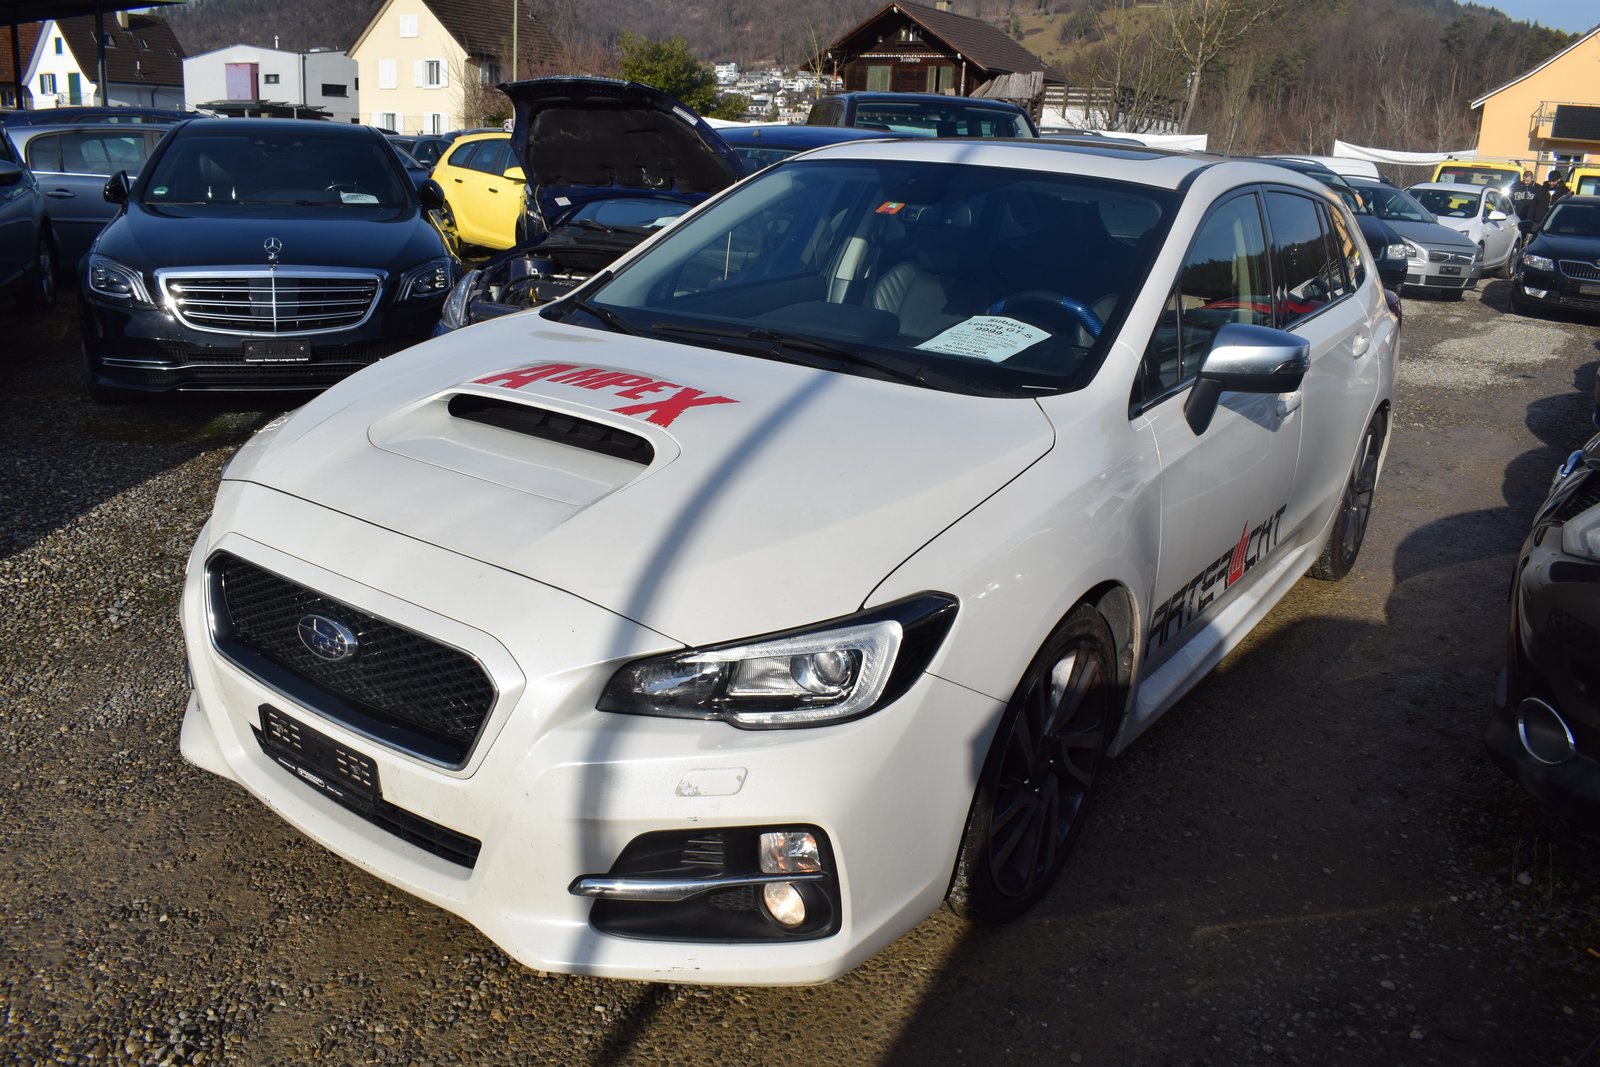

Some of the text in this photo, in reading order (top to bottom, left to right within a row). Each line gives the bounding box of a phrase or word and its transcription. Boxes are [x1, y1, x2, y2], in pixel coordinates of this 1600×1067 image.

[967, 321, 1033, 339] Levorg GT-S
[988, 318, 1025, 330] Subaru
[471, 363, 741, 428] AMPEX
